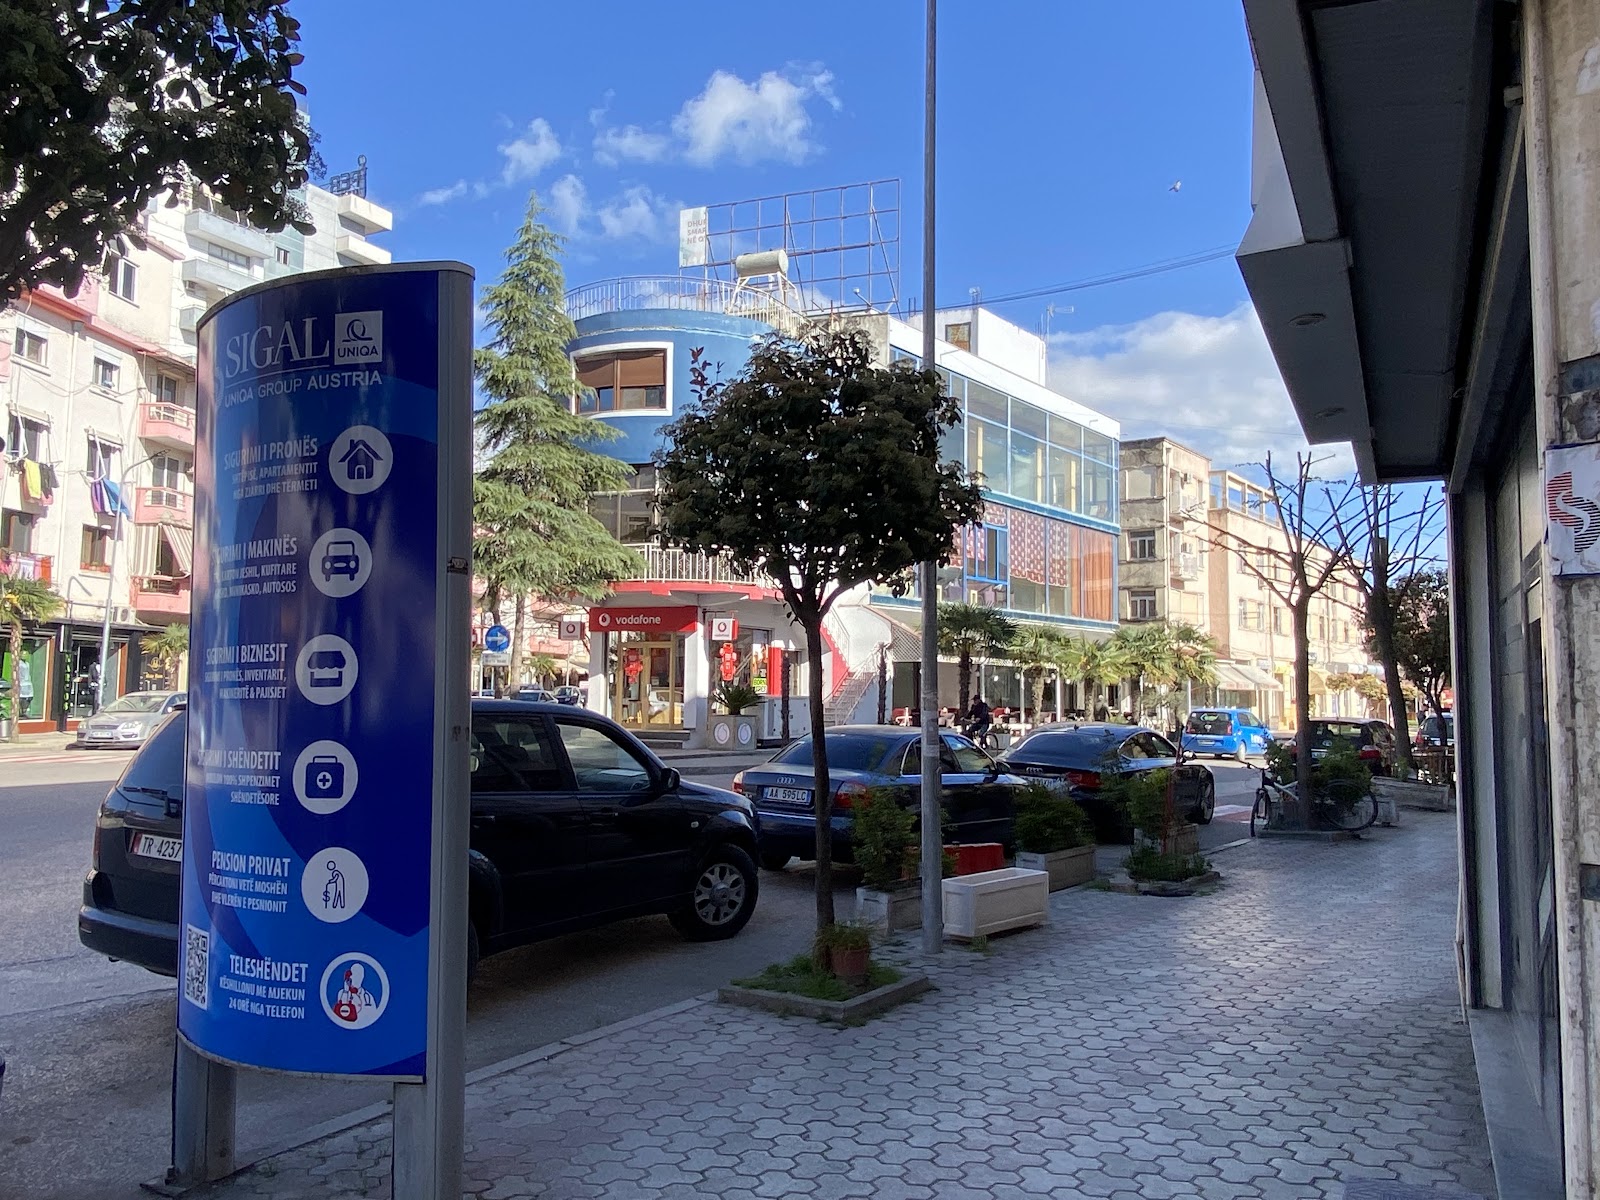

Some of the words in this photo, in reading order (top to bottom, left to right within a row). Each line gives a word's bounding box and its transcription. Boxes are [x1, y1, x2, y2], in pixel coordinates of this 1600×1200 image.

[225, 317, 330, 378] SIGAL
[337, 345, 379, 358] UNIQA
[224, 386, 254, 409] UNIQA
[257, 378, 303, 398] GROUP
[306, 370, 383, 390] AUSTRIA
[224, 445, 261, 470] SIGURIMI
[269, 434, 318, 459] PRONËS
[259, 461, 319, 479] APARTAMENTIT
[266, 482, 281, 494] DHE
[281, 478, 318, 492] TËRMETI
[247, 533, 298, 559] MAKINËS
[261, 562, 297, 576] KUFITARE
[262, 579, 297, 593] AUTOSOS
[615, 613, 662, 625] vodafone
[240, 643, 289, 662] BIZNESIT
[244, 668, 287, 682] INVENTARIT,
[249, 685, 256, 698] &
[256, 686, 287, 698] PAJISJET
[227, 746, 282, 770] SHËNDETIT
[238, 774, 281, 787] SHPENZIMET
[230, 789, 280, 805] SHËNDETËSORE
[768, 788, 780, 799] AA
[782, 790, 807, 802] 595LC
[142, 836, 154, 854] TR
[156, 839, 182, 860] 4237
[211, 850, 246, 873] PENSION
[248, 855, 292, 877] PRIVAT
[238, 877, 255, 891] VETË
[254, 879, 288, 894] MOSHËN
[229, 953, 309, 982] TELESHËNDET
[255, 984, 267, 997] ME
[267, 986, 306, 1000] MJEKUN
[228, 997, 237, 1009] 24
[237, 997, 250, 1012] ORË
[250, 1001, 265, 1015] NGA
[265, 1004, 305, 1019] TELEFON
